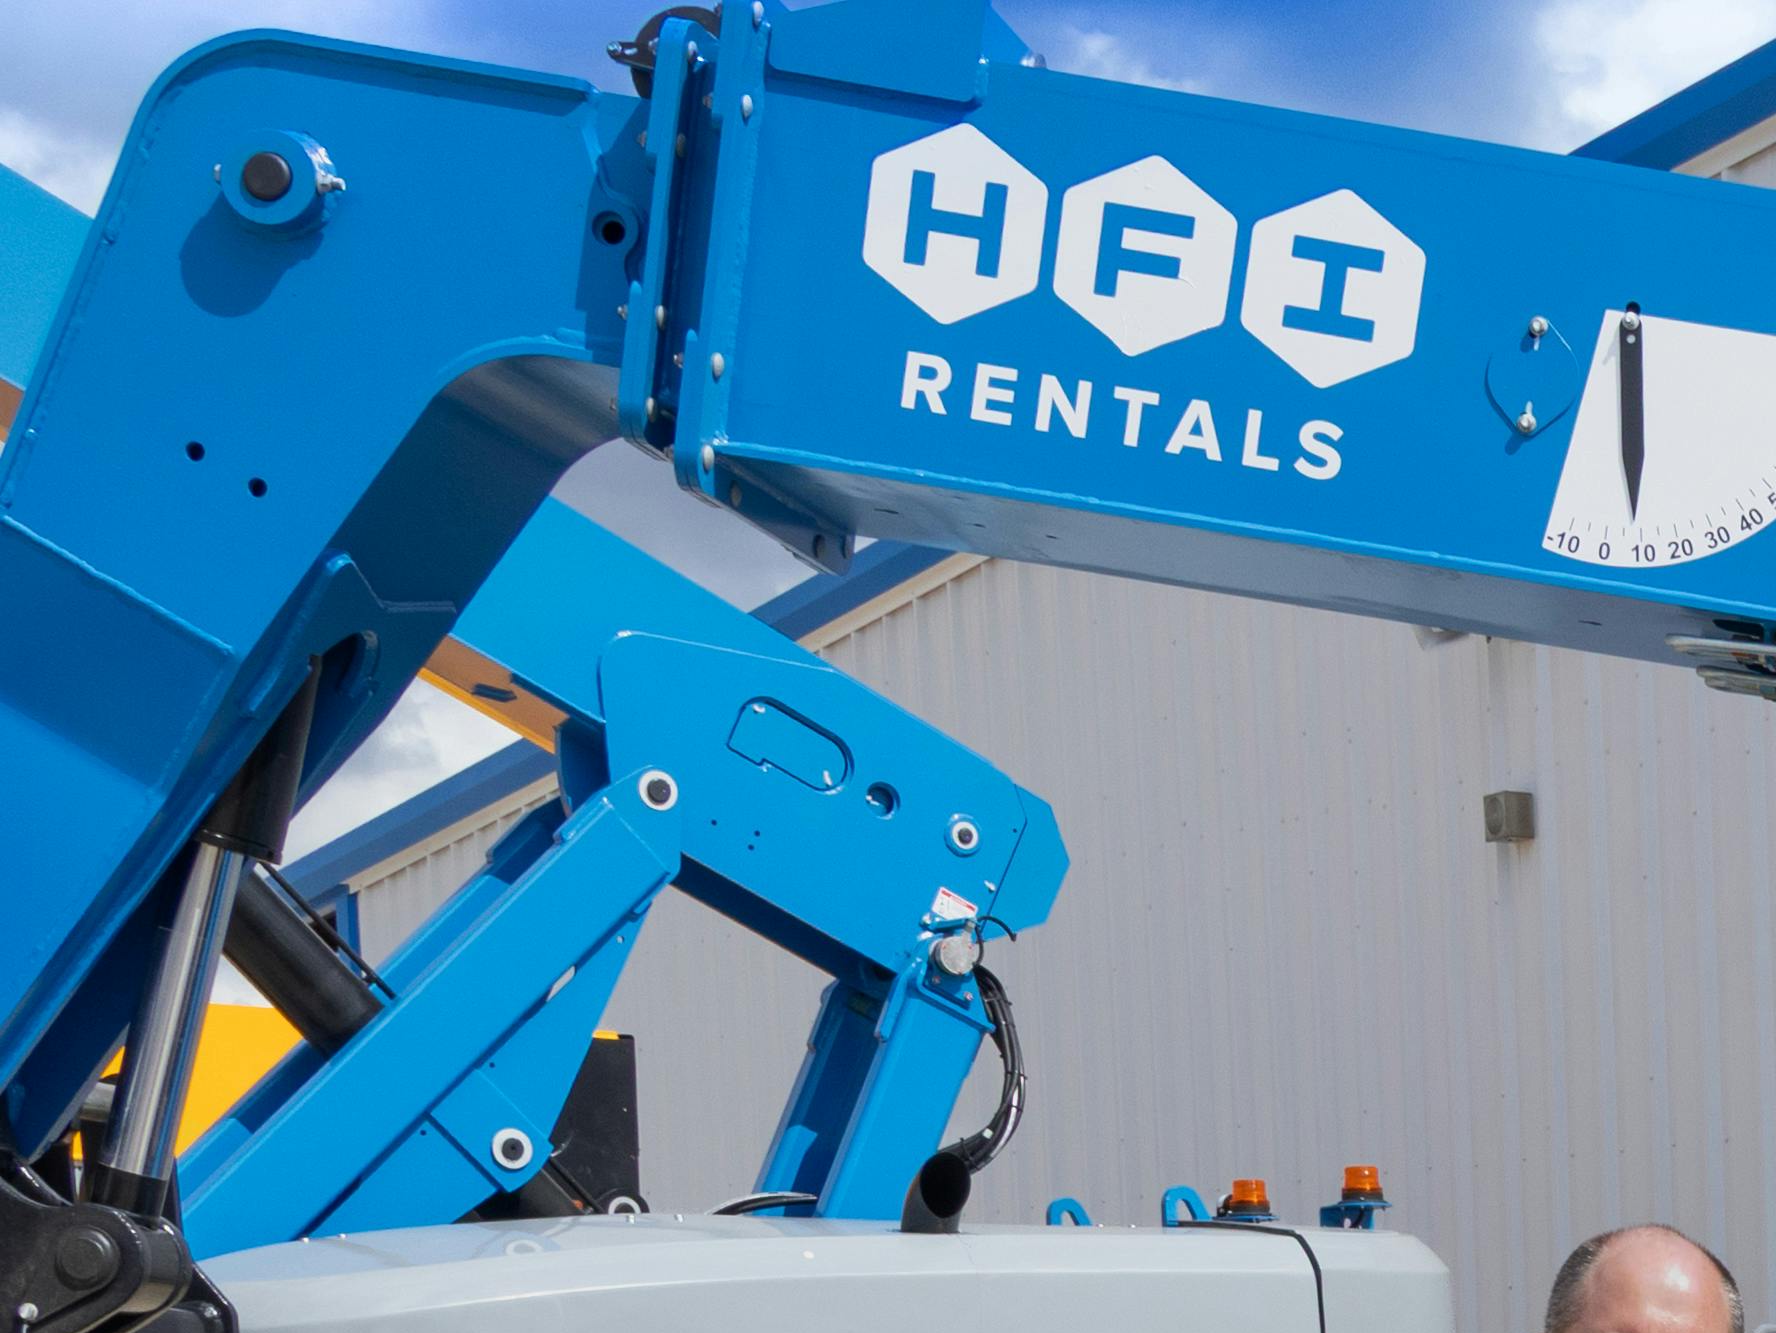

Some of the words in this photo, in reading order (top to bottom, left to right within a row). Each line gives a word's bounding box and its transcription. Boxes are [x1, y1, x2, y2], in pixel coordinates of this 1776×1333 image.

[900, 350, 1345, 481] RENTALS
[1546, 533, 1581, 556] -10
[1597, 542, 1611, 562] 0
[1631, 543, 1656, 563] 10
[1669, 538, 1695, 561] 20
[1704, 525, 1732, 551] 30
[1737, 507, 1765, 534] 40
